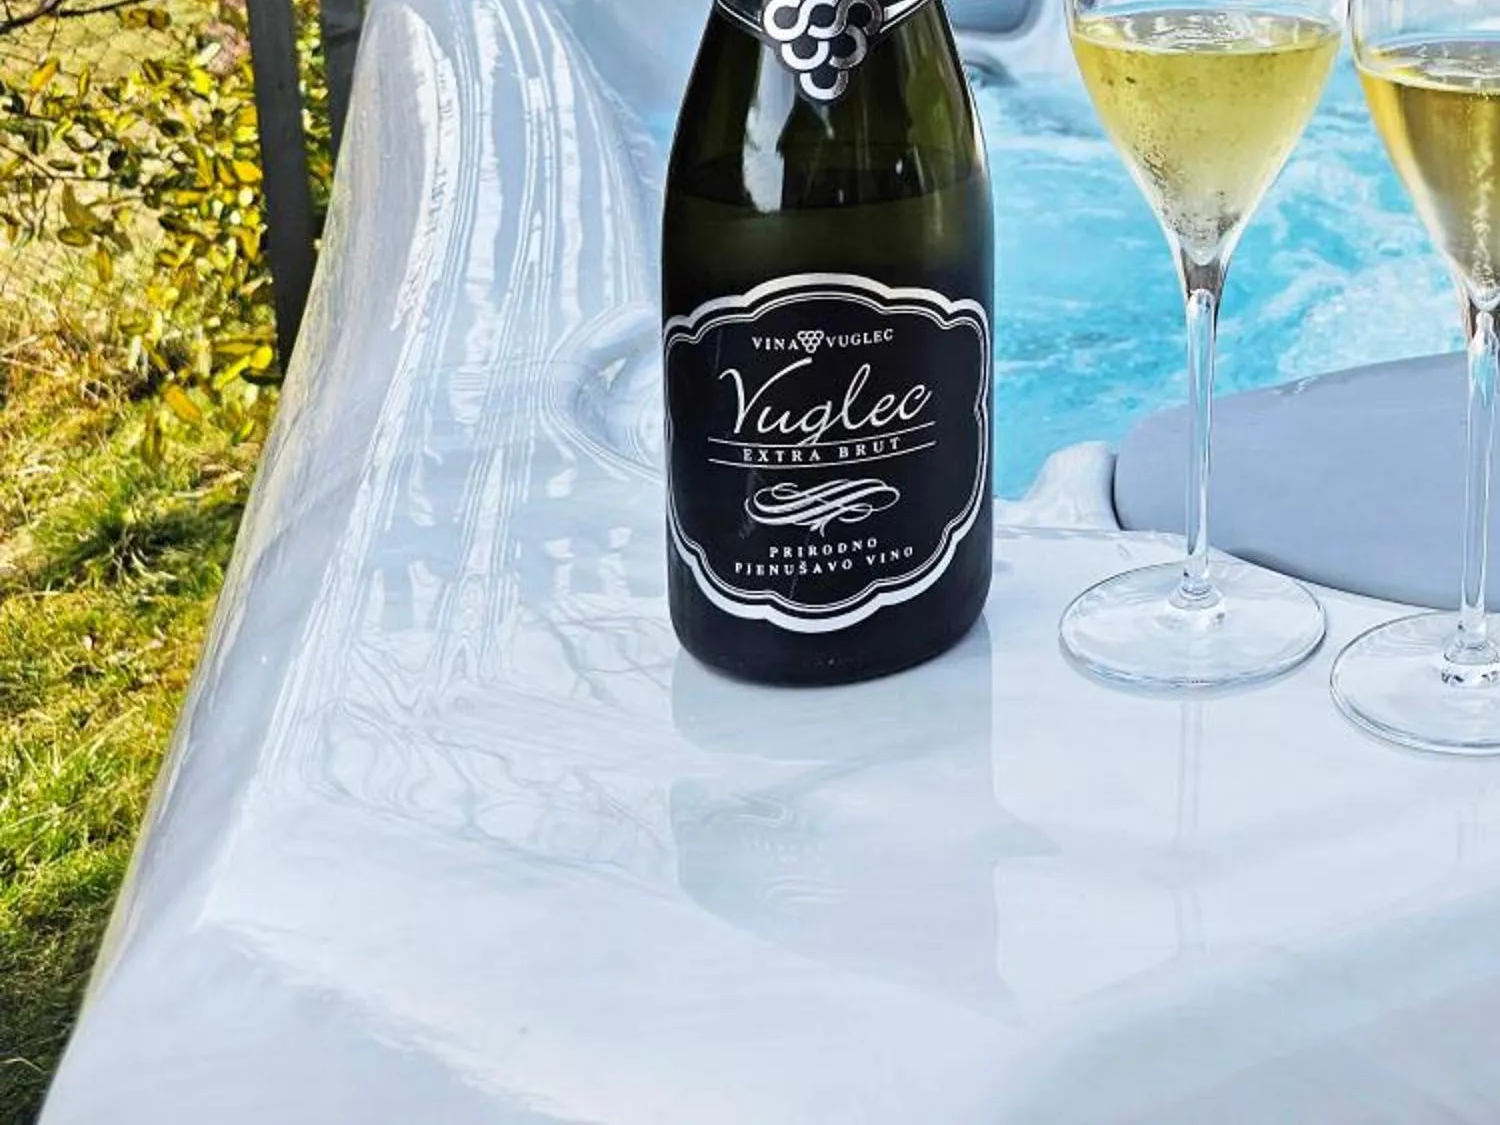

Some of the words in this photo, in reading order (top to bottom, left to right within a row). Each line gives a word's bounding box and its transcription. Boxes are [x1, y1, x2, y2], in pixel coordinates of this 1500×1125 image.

[752, 336, 799, 351] VINA
[825, 328, 894, 348] VUGLEC
[718, 357, 933, 446] Vuglec
[743, 448, 821, 463] EXTRA
[839, 437, 901, 459] BRUT
[769, 537, 878, 558] PRIRODNO
[866, 546, 914, 566] VINO
